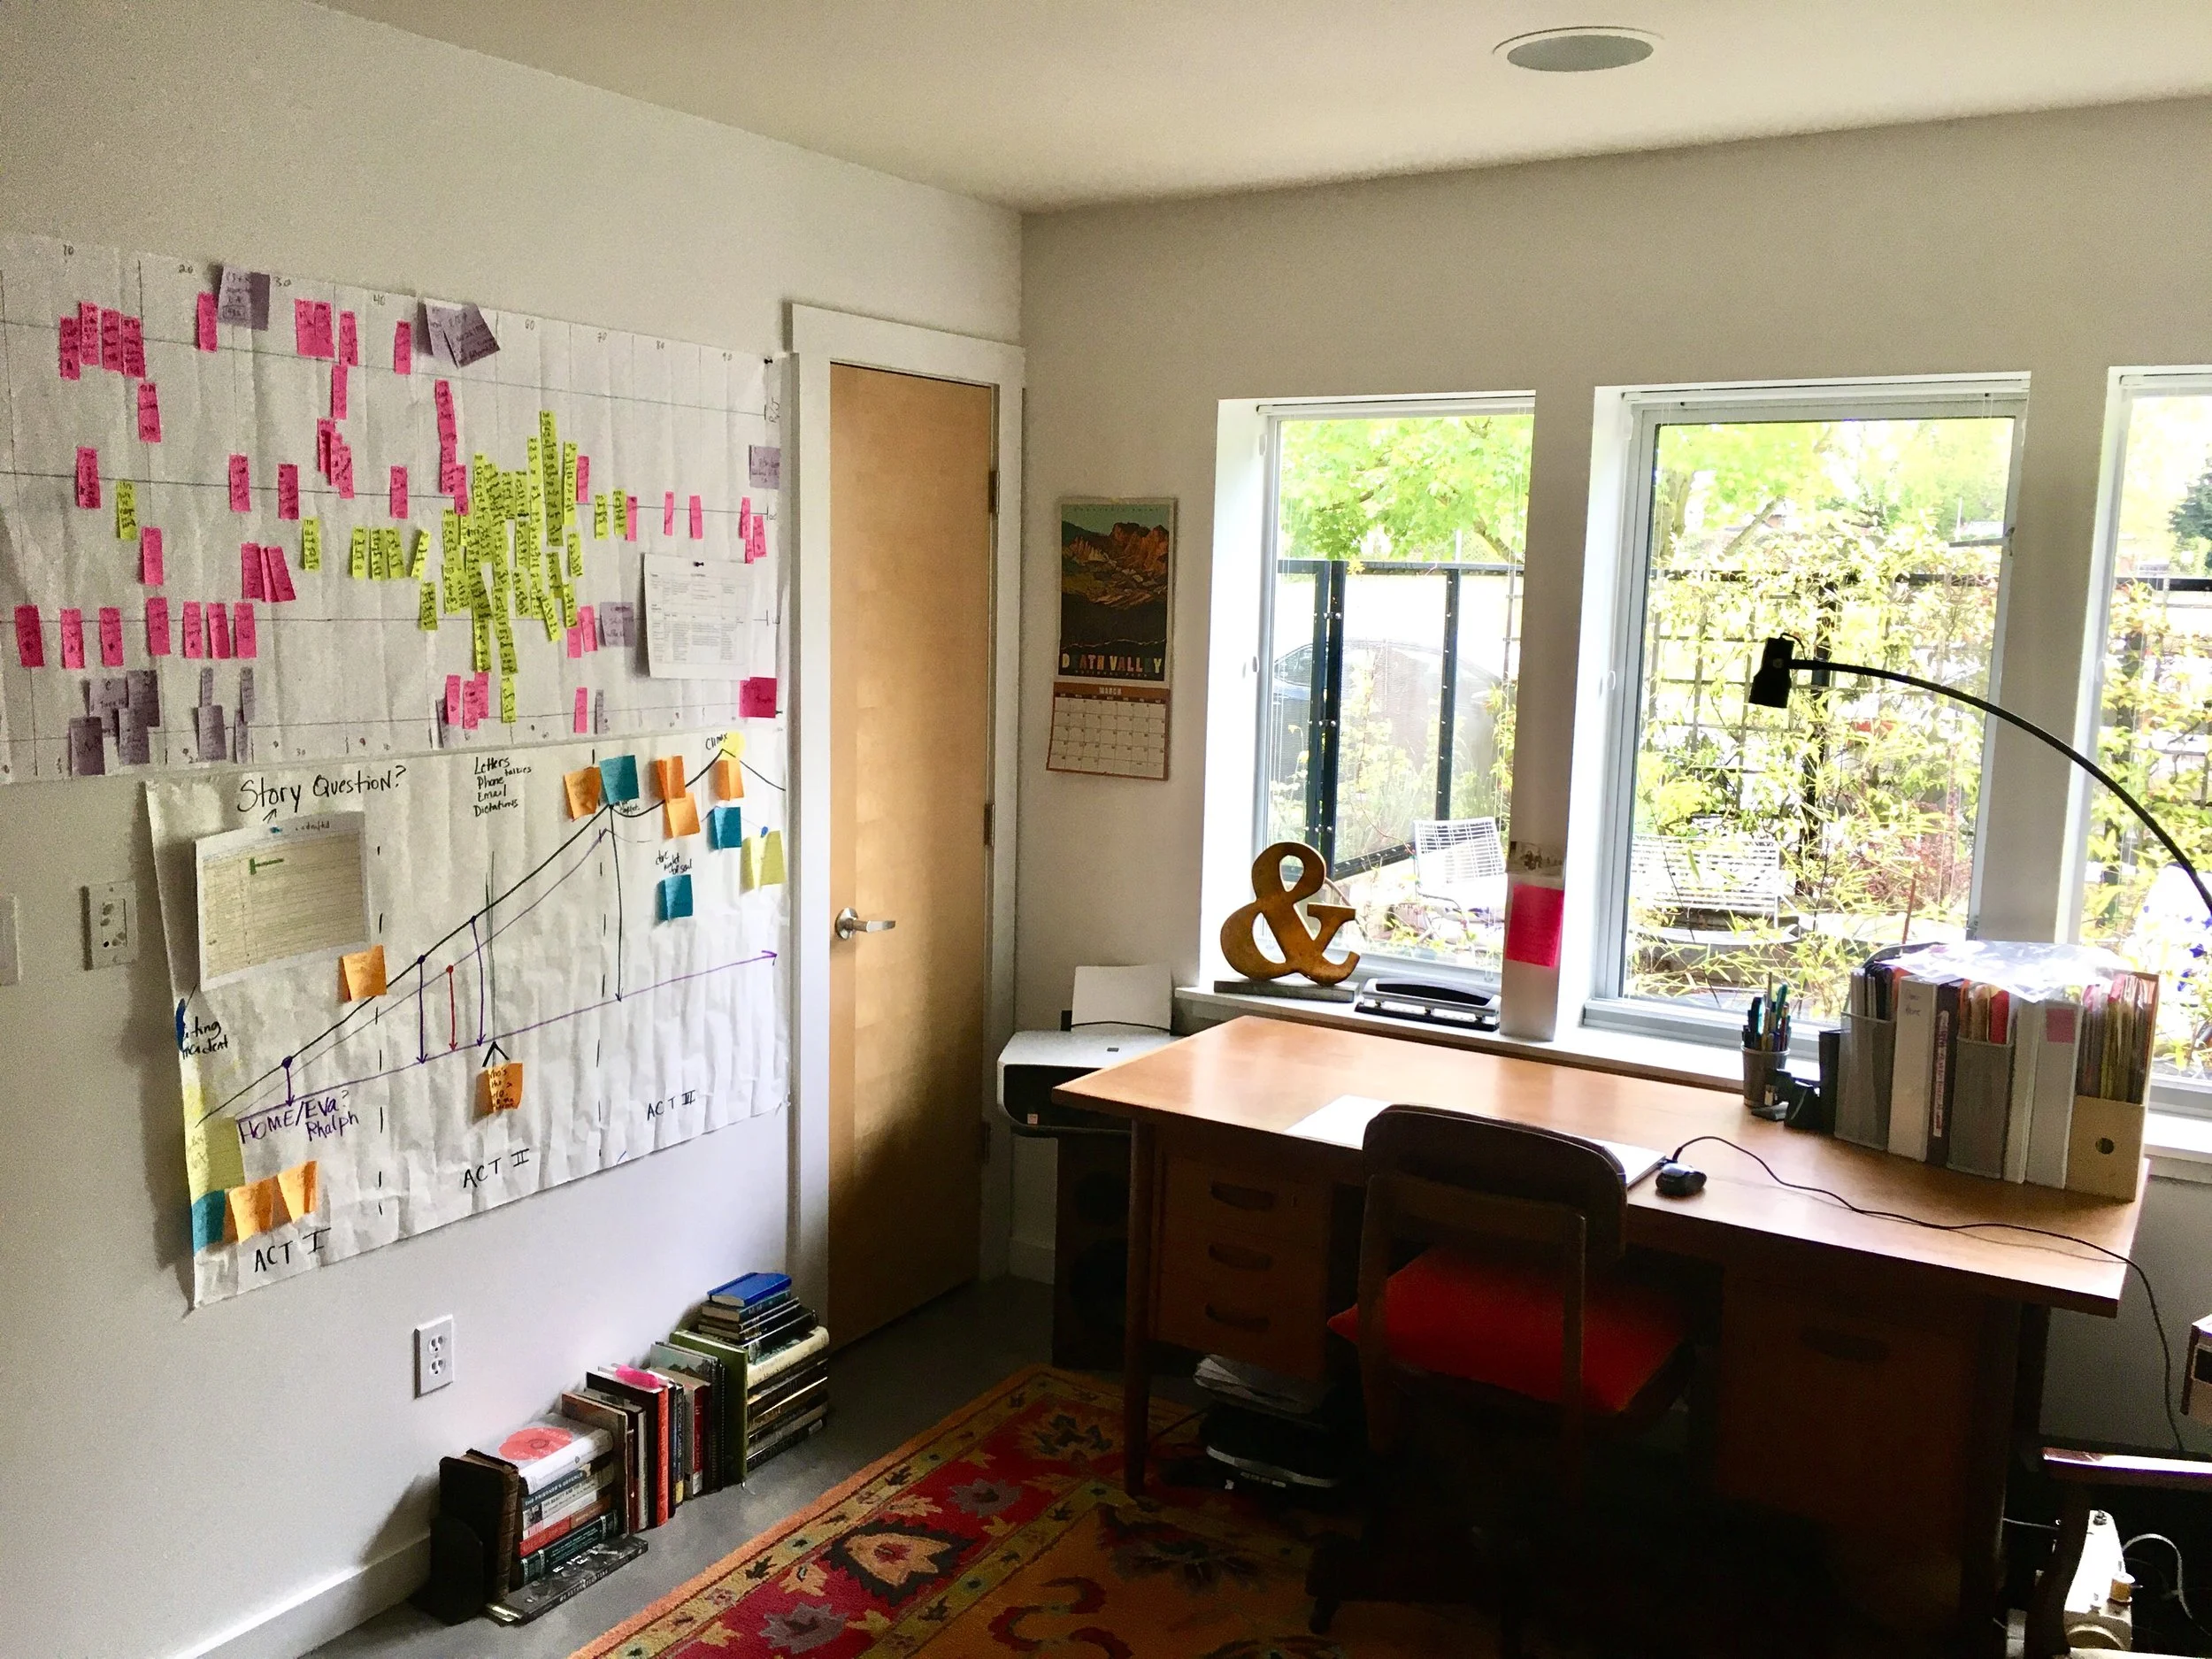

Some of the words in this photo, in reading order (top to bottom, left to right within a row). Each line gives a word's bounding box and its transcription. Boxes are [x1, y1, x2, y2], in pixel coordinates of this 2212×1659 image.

[1062, 653, 1104, 671] DATH
[1110, 655, 1163, 674] VALLY
[474, 757, 511, 774] Letters
[237, 777, 301, 813] Story
[477, 775, 504, 790] Phone
[478, 784, 506, 803] Email
[647, 1095, 676, 1121] ACT
[305, 1111, 359, 1142] Rhalph
[463, 1156, 502, 1188] ACT
[511, 1148, 530, 1168] II
[254, 1240, 294, 1273] ACT
[302, 1226, 332, 1256] I
